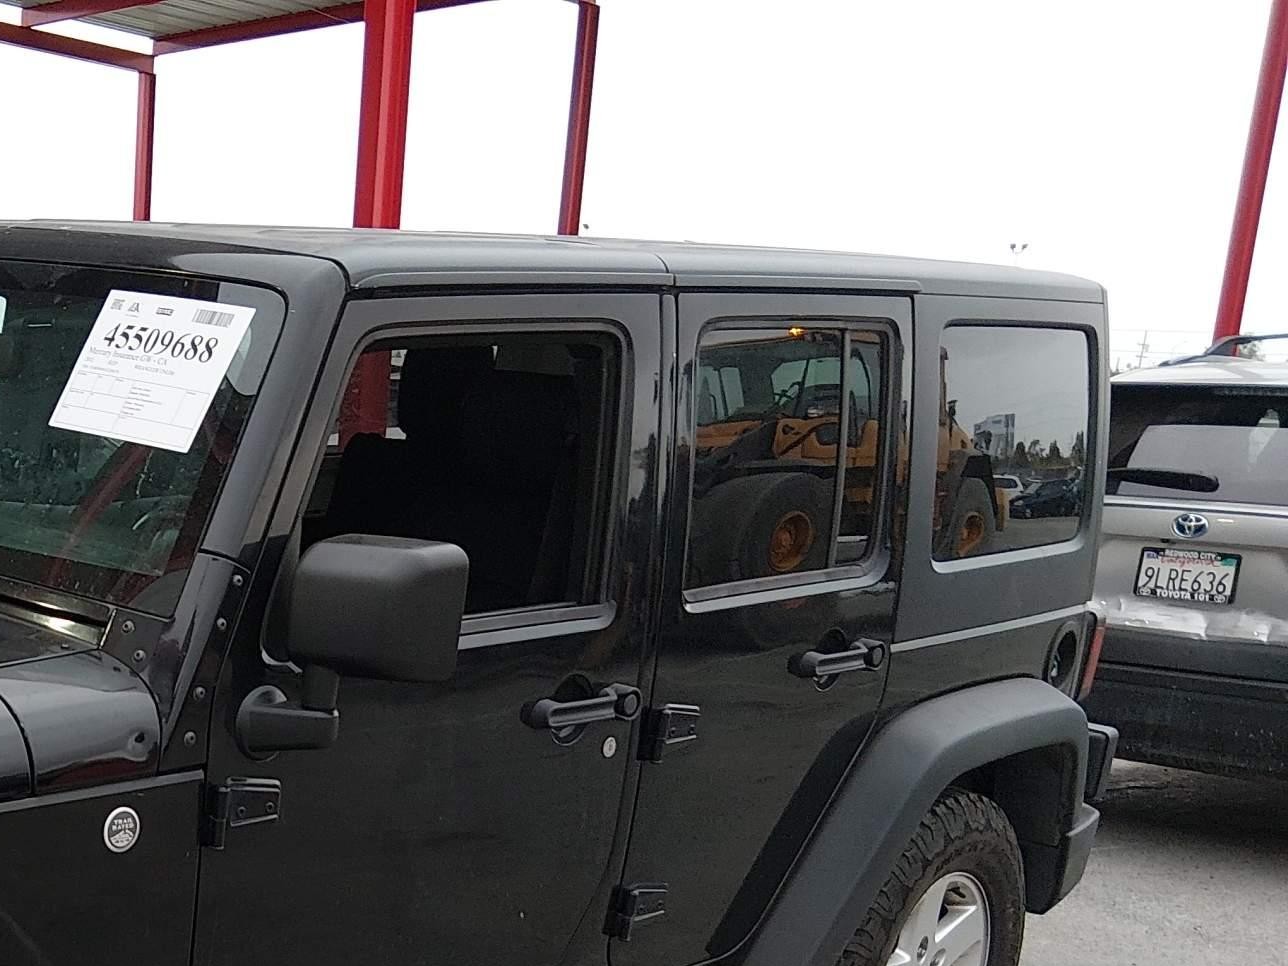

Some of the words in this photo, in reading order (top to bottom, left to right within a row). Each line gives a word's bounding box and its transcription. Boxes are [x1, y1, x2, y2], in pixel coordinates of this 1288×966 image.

[103, 322, 220, 364] 45509688
[1199, 551, 1217, 561] CITY
[1141, 566, 1230, 595] 9LRE636
[1155, 588, 1192, 601] TOYOTA
